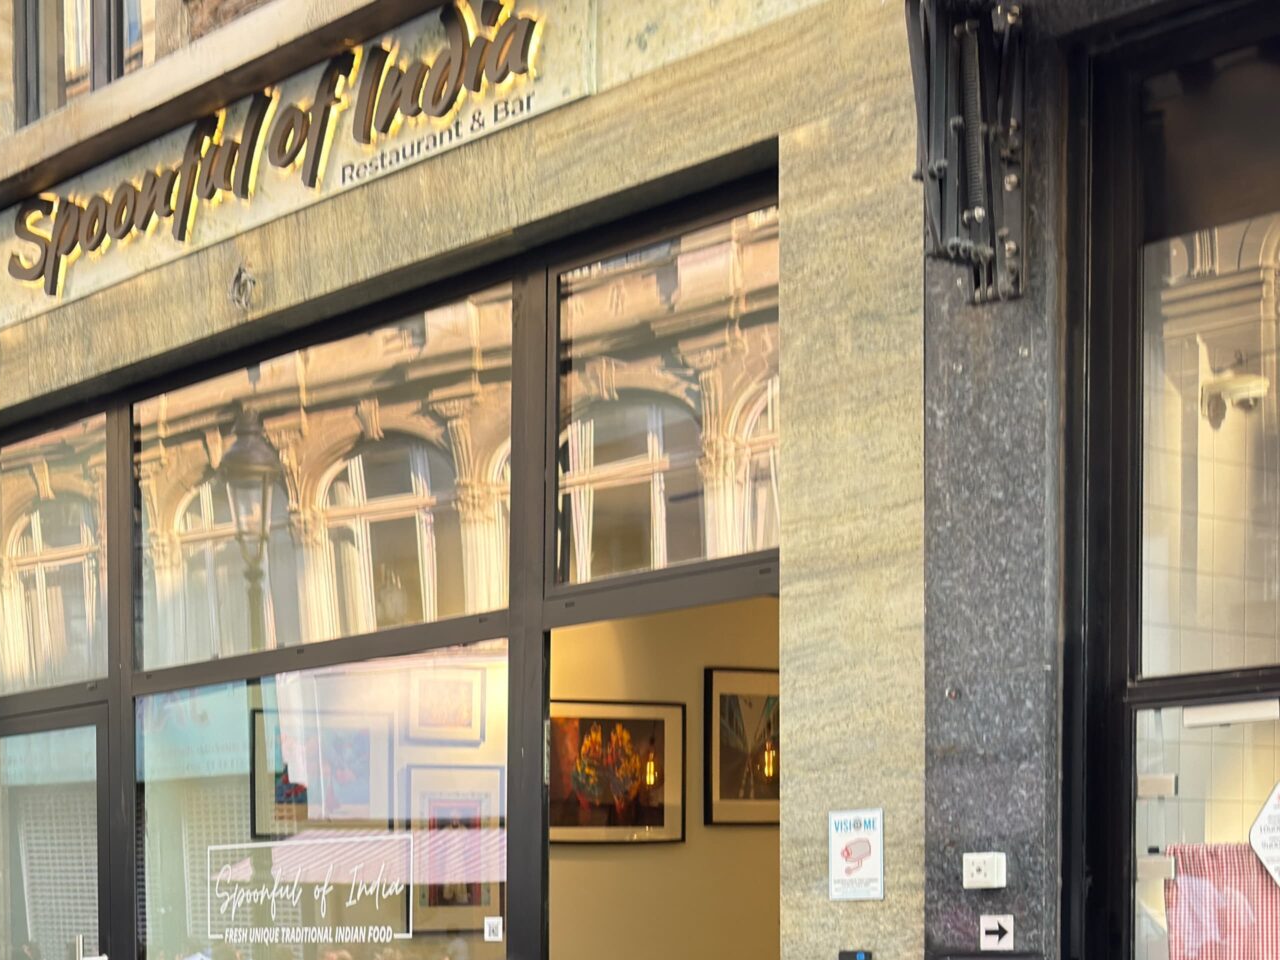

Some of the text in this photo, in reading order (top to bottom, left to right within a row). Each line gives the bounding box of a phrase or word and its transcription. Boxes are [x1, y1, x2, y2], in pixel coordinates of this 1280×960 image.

[8, 0, 536, 297] Spoonful of India
[342, 93, 535, 185] Restaurant & Bar
[216, 862, 405, 921] Spoonful of India
[225, 926, 392, 946] FRESH UNIQUE TRADITIONAL INDIAN FOOD
